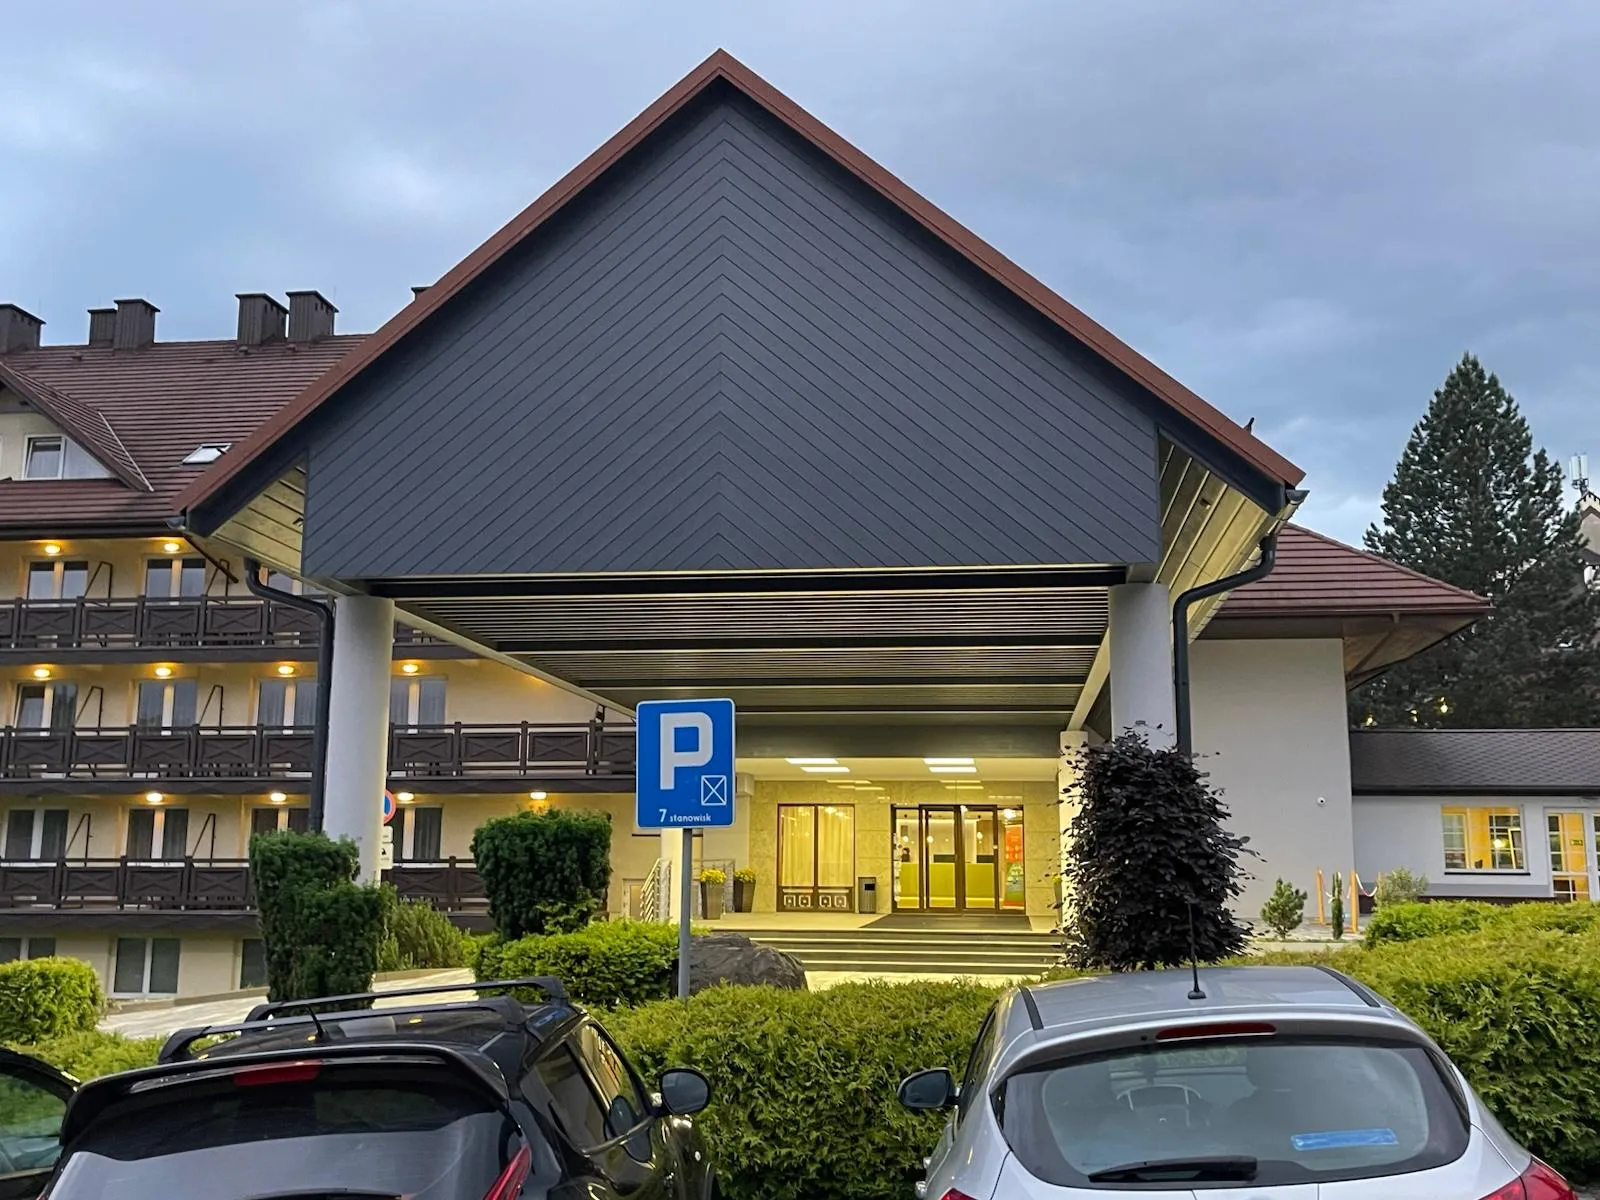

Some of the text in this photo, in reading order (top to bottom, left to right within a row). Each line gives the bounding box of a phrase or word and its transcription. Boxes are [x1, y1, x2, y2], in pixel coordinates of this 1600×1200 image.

[660, 712, 713, 789] P
[659, 809, 712, 823] 7 stanowisk
